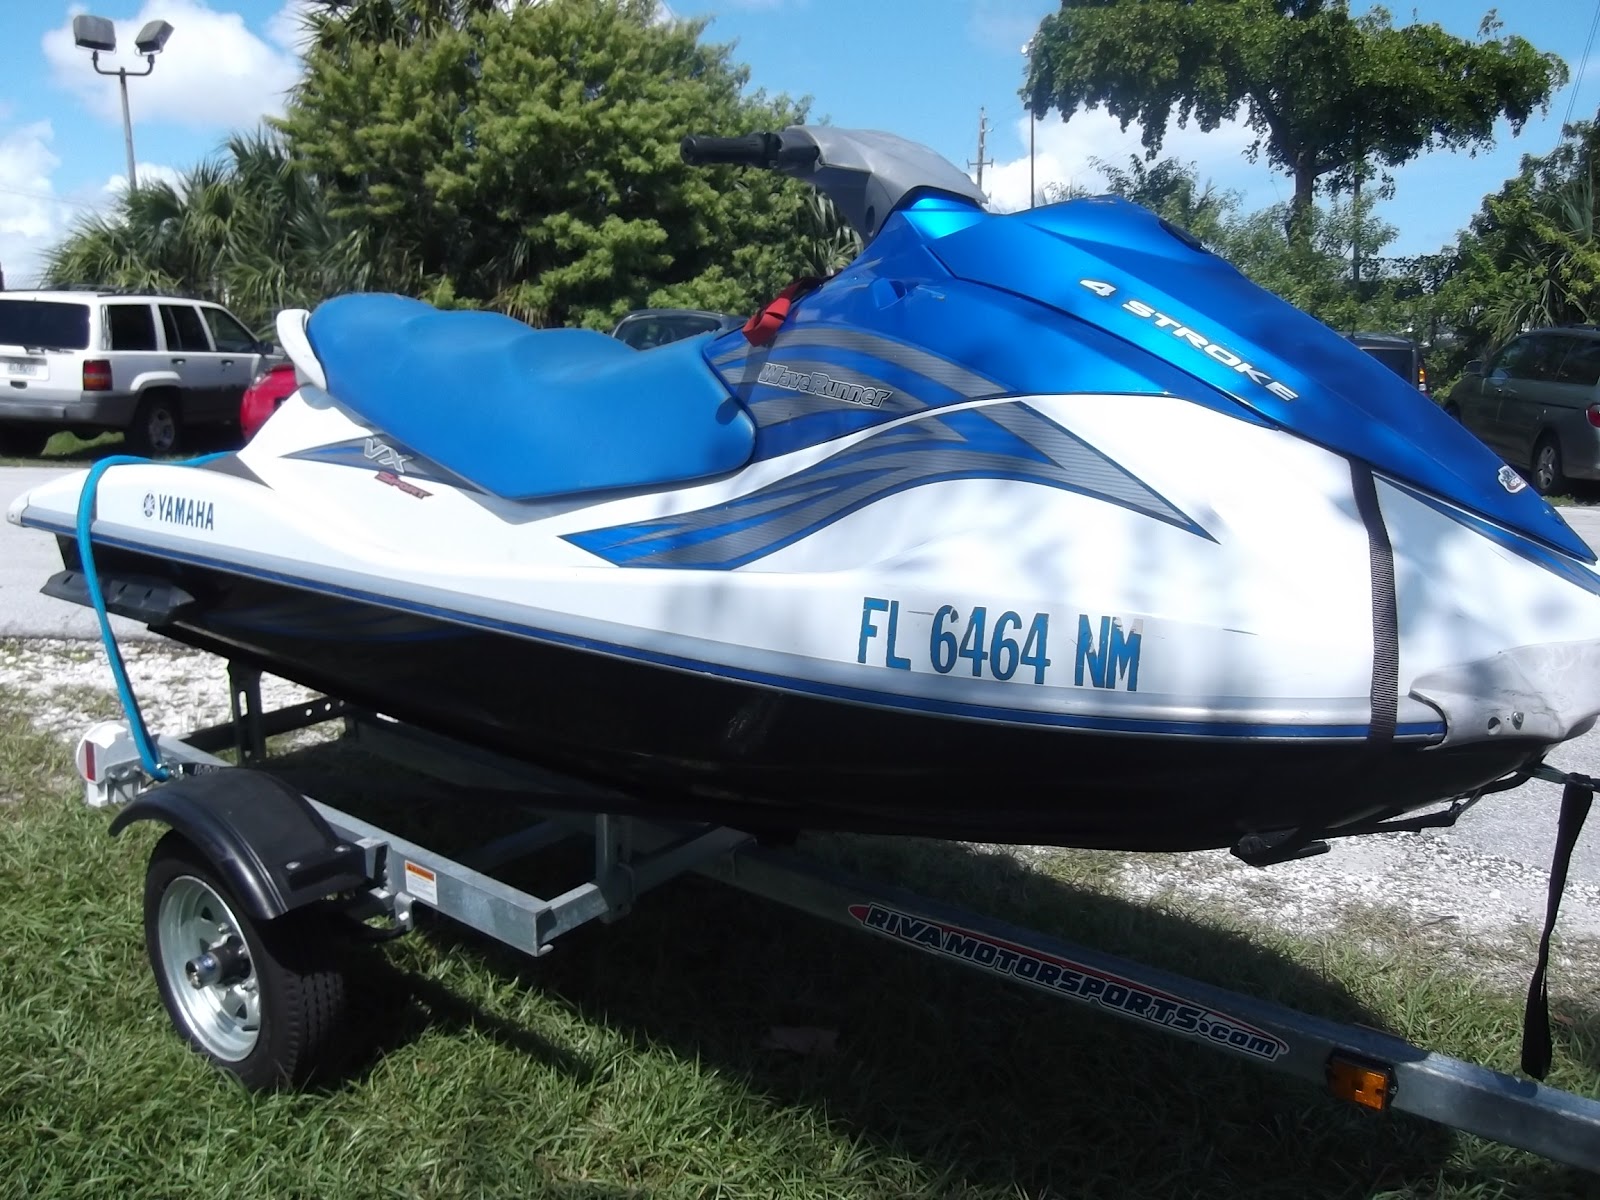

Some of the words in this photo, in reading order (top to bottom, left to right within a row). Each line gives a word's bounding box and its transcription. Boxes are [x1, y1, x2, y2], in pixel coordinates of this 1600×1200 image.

[1079, 279, 1117, 297] 4
[1121, 299, 1299, 402] STROKE
[758, 362, 893, 408] WaveRunner
[363, 437, 407, 474] VX
[158, 494, 214, 530] YAMAHA
[857, 597, 911, 671] FL
[929, 604, 1051, 685] 6464
[1074, 613, 1144, 692] NM
